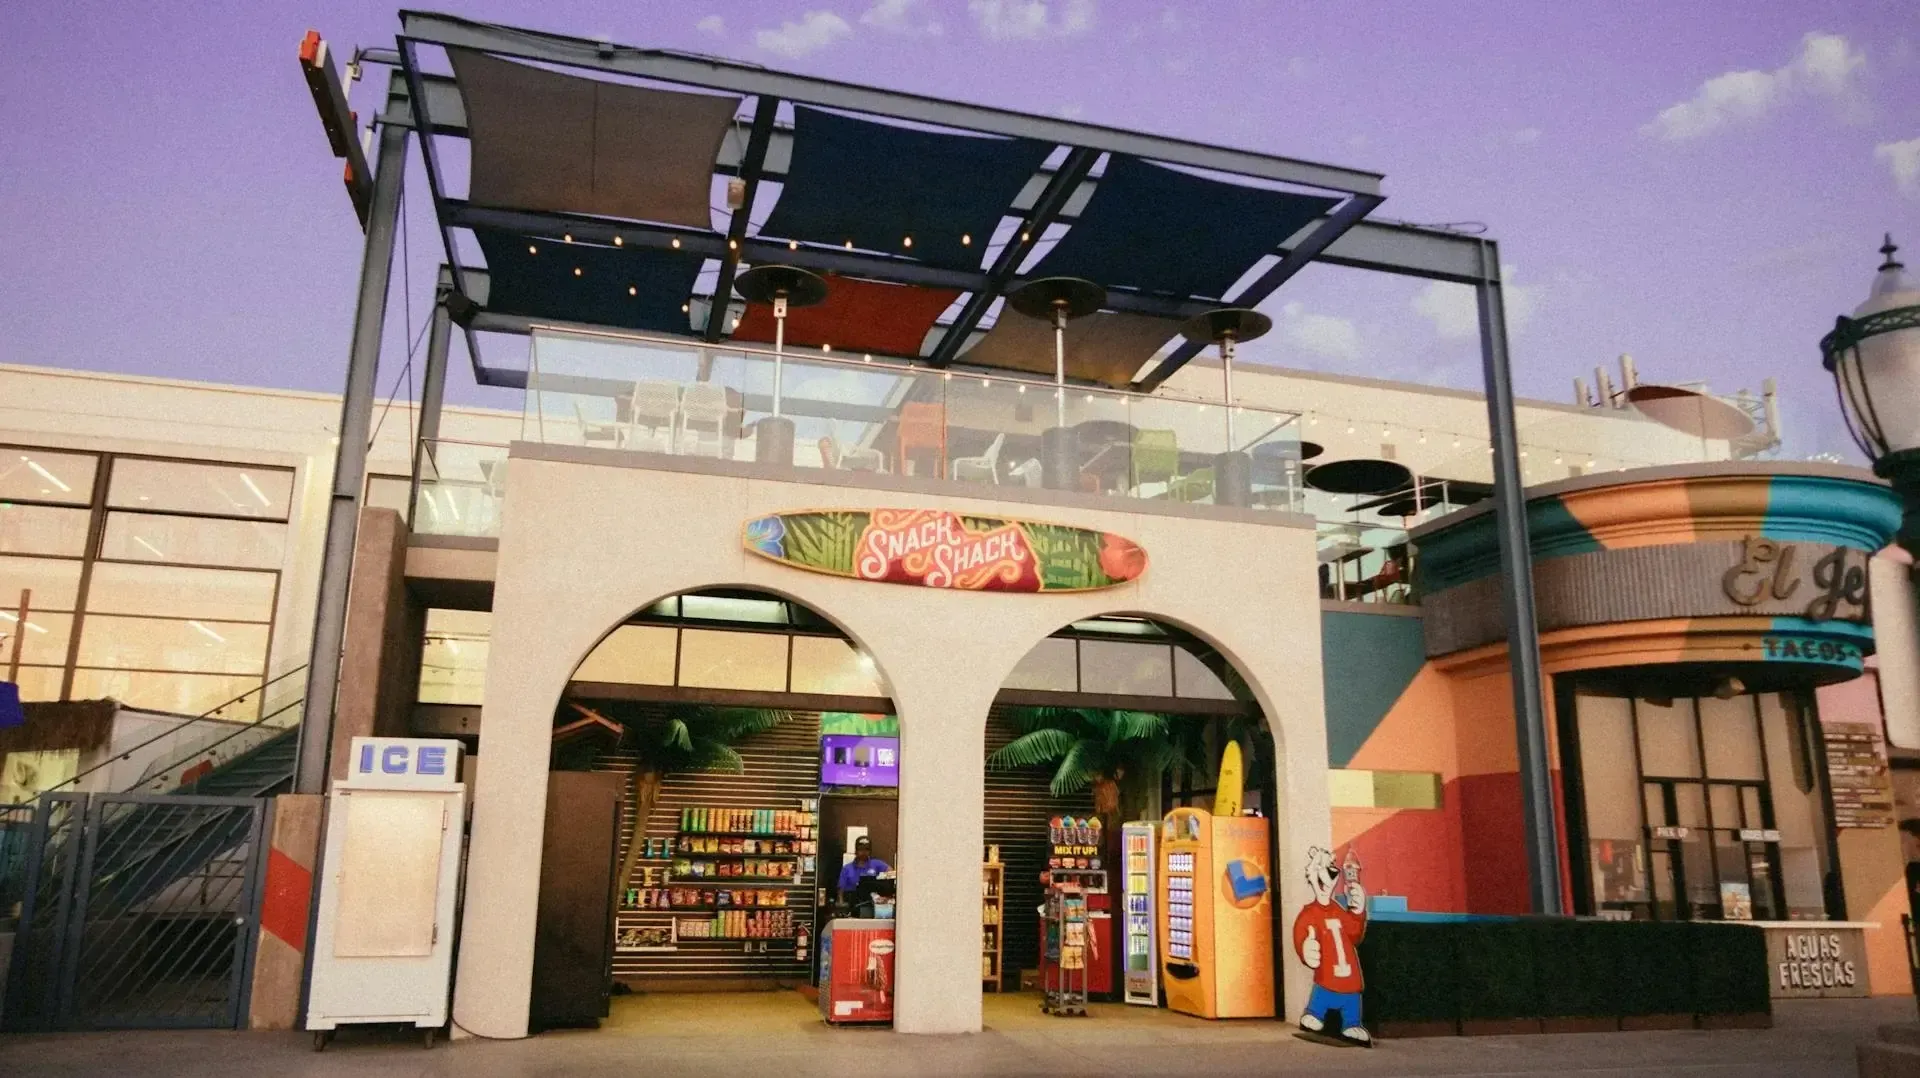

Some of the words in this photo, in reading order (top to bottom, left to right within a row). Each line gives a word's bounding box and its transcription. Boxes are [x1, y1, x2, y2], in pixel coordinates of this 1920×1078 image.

[860, 515, 961, 579] SNACK
[926, 530, 1025, 588] SHACK
[1722, 534, 1800, 606] El
[1763, 638, 1846, 661] TACOS
[359, 744, 447, 775] ICE
[1786, 934, 1841, 960] AGUAS
[1779, 960, 1856, 988] FRESCAS
